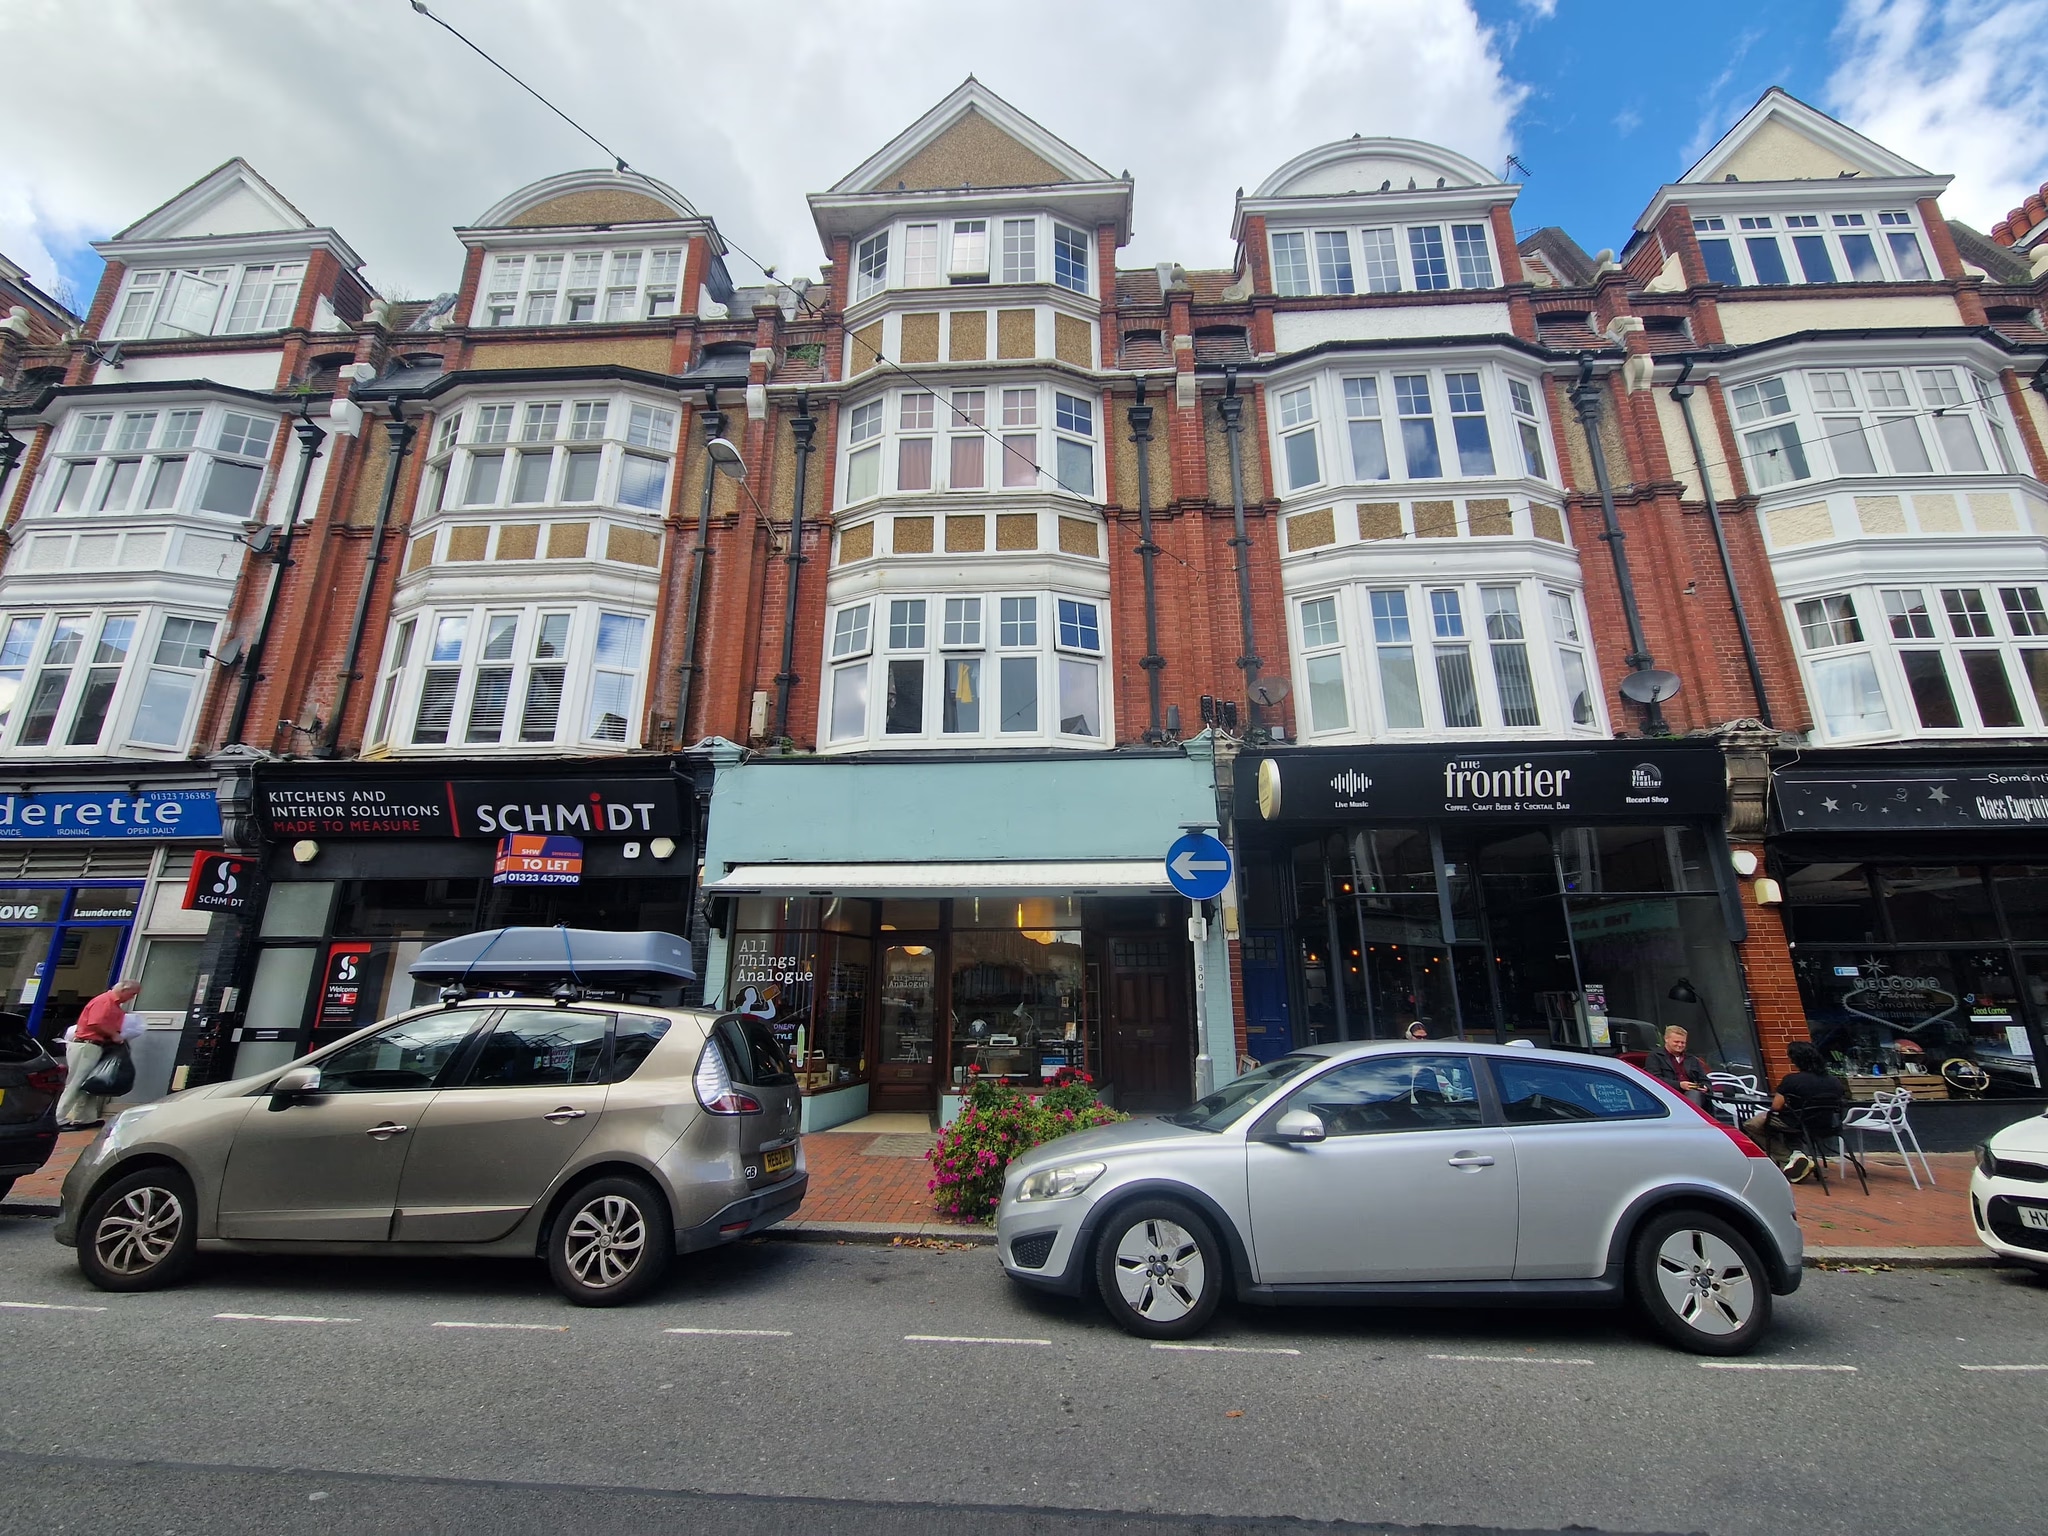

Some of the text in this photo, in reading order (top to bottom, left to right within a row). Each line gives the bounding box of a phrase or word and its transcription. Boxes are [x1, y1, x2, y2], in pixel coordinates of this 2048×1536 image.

[1443, 762, 1571, 798] frontier
[180, 792, 211, 800] 736385
[269, 790, 386, 803] KITCHENS AND
[1625, 796, 1669, 804] Record Shop
[271, 805, 440, 818] INTERIOR SOLUTIONS
[1514, 802, 1521, 811] &
[1976, 796, 2008, 820] Glass
[273, 820, 420, 832] MADE TO MEASURE
[57, 828, 90, 836] IRONING
[521, 848, 540, 856] SHW
[522, 859, 569, 871] TO LET
[508, 873, 579, 883] 01323 437900
[0, 905, 39, 920] ove
[74, 908, 132, 917] Launderette
[740, 940, 768, 953] All
[738, 954, 796, 969] Things
[736, 969, 814, 984] Analogue
[889, 981, 929, 989] Analogue
[1854, 976, 1940, 991] WELCOME
[1866, 1000, 1936, 1010] Semantics
[1972, 1007, 2007, 1015] Food Corner
[746, 1167, 755, 1178] GB
